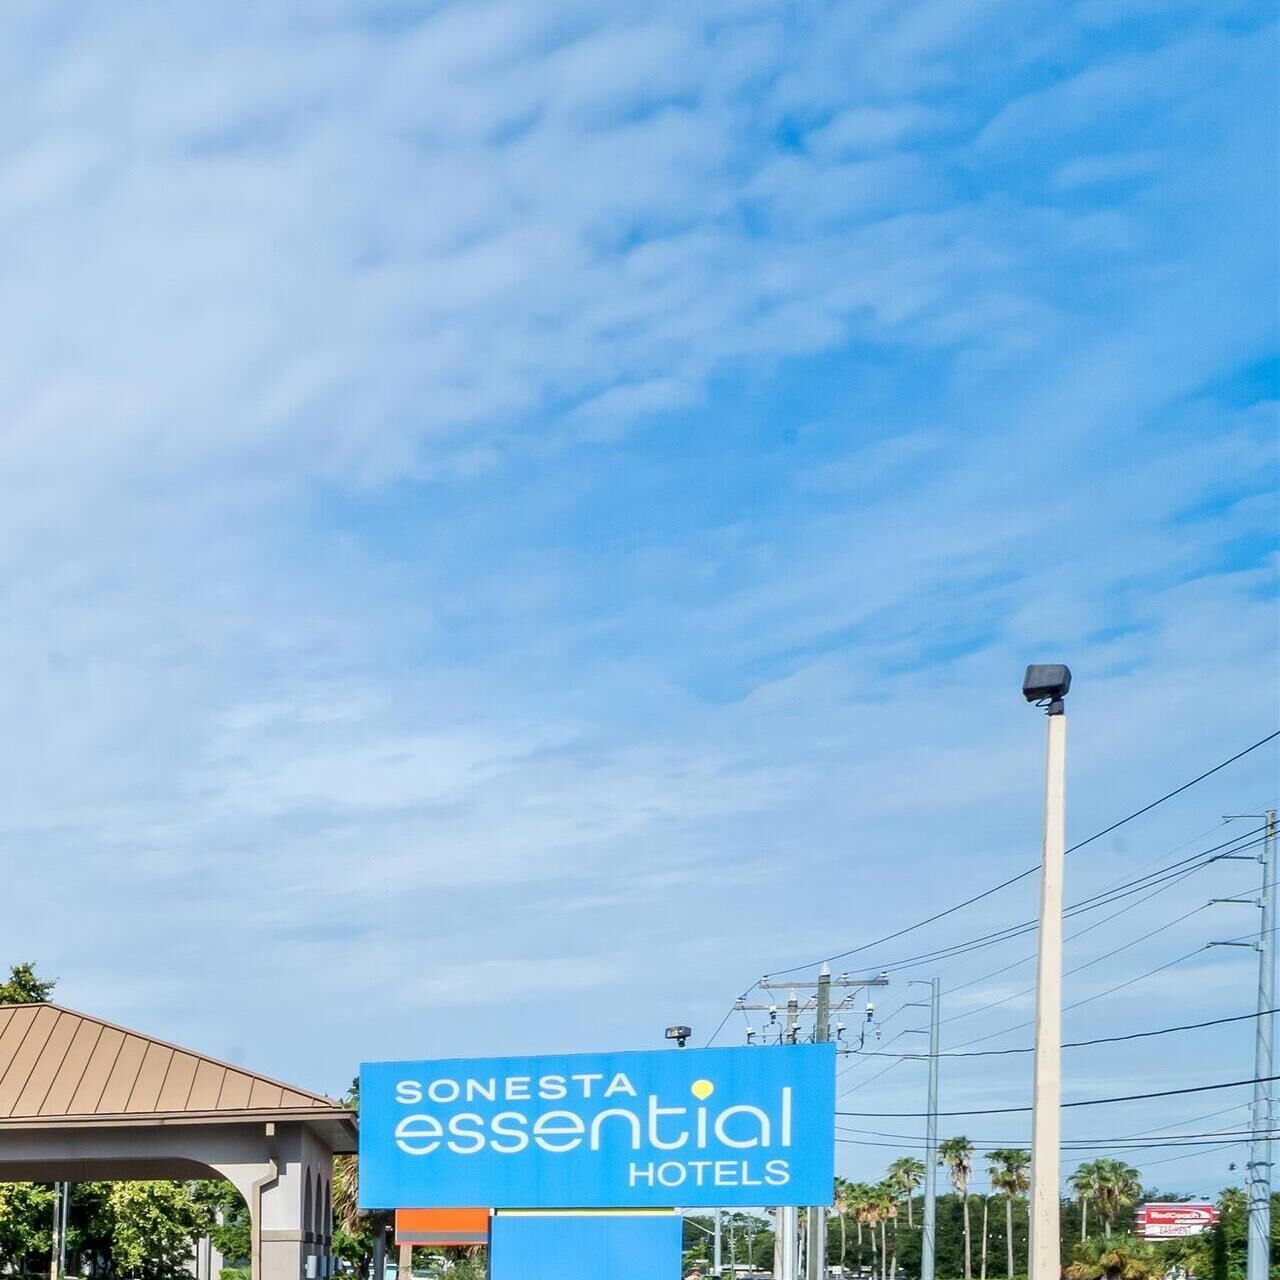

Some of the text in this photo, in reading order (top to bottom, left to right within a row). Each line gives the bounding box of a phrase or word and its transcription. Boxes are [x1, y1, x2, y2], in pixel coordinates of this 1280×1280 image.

[395, 1073, 637, 1104] SONESTA
[395, 1079, 792, 1155] essential
[629, 1159, 791, 1187] HOTELS
